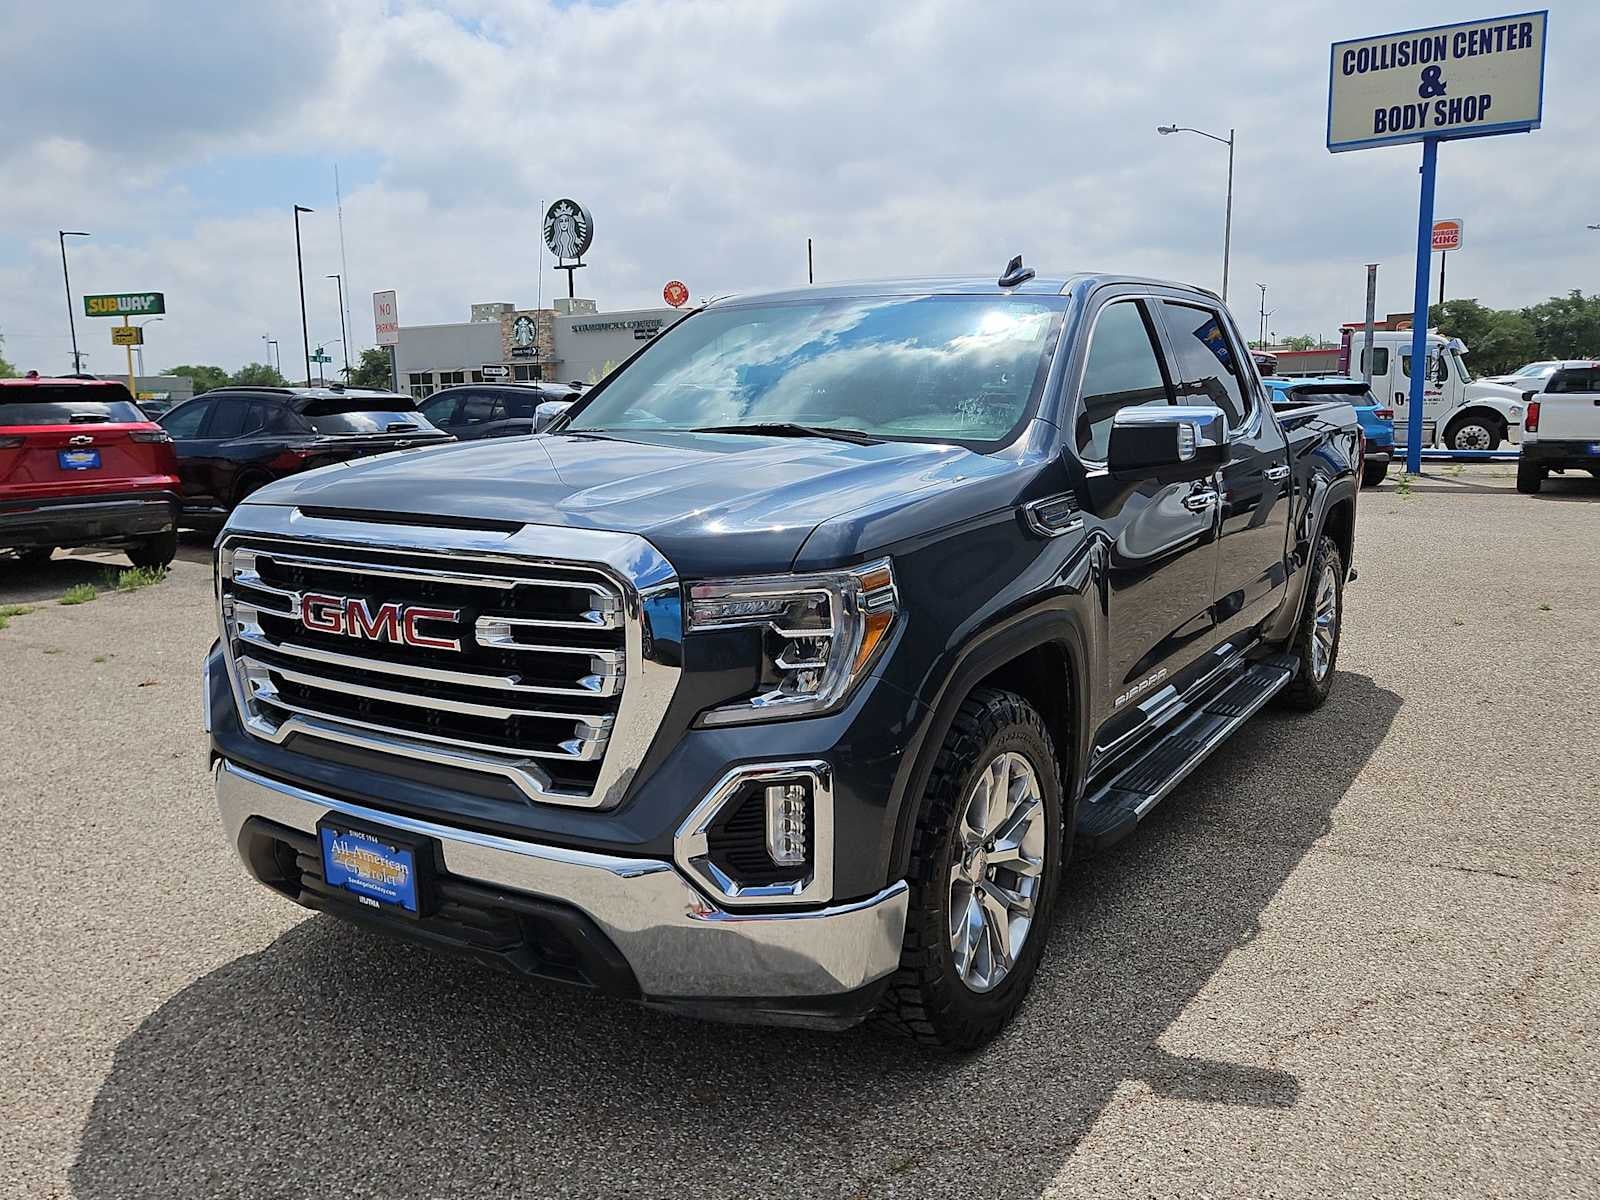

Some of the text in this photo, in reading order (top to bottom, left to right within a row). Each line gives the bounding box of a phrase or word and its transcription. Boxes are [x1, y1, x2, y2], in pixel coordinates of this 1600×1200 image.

[1342, 22, 1533, 76] COLLISION CENTER
[1418, 65, 1447, 99] &
[1374, 94, 1492, 134] BODY SHOP
[1432, 235, 1458, 244] KING
[88, 295, 155, 313] SUBWAY
[379, 303, 391, 316] NO
[376, 322, 398, 333] PARKING
[301, 592, 462, 652] GMC
[349, 829, 366, 840] SINCE
[331, 840, 409, 875] All American
